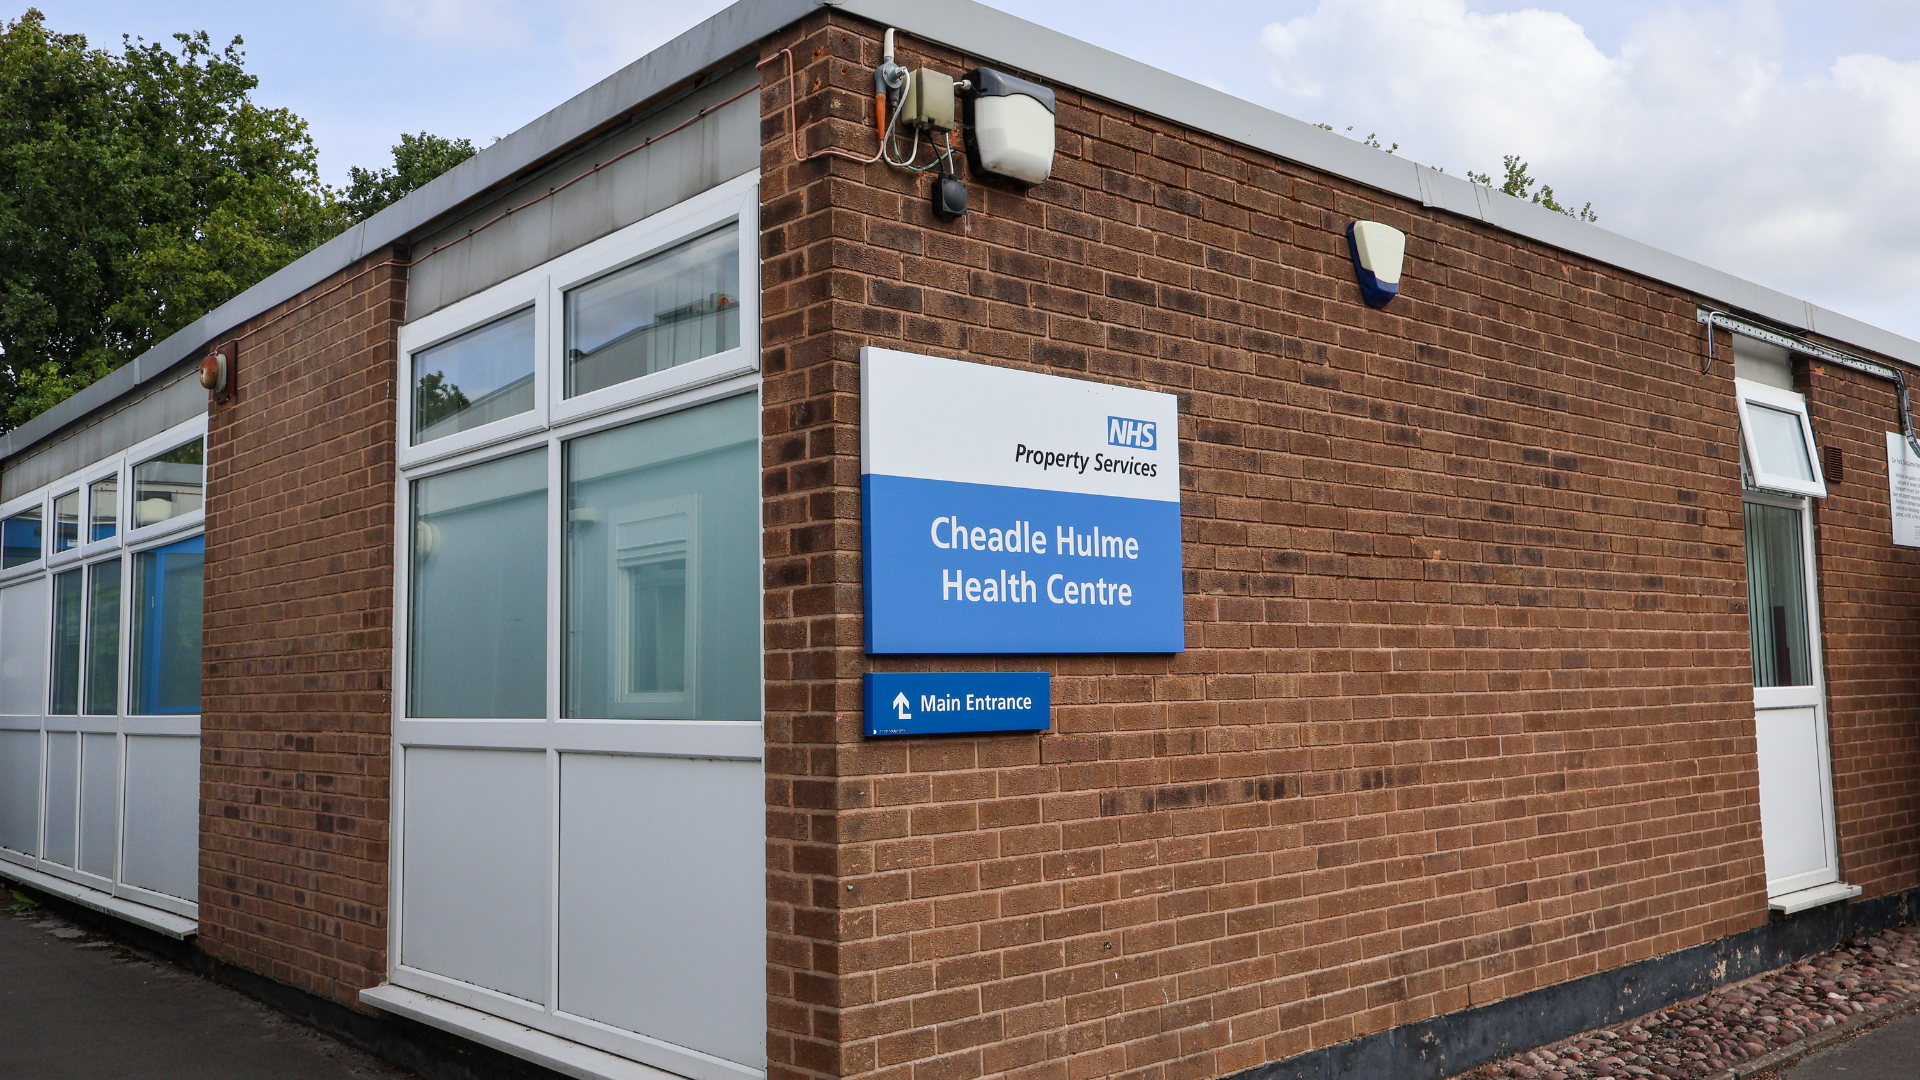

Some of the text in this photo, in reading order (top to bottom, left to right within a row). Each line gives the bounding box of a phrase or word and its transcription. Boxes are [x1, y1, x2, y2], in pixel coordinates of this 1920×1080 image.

[1109, 418, 1155, 448] NHS
[1015, 443, 1158, 478] Property Services
[930, 515, 1139, 560] Cheadle Hulme
[942, 568, 1132, 606] Health Centre
[920, 693, 1032, 712] Main Entrance
